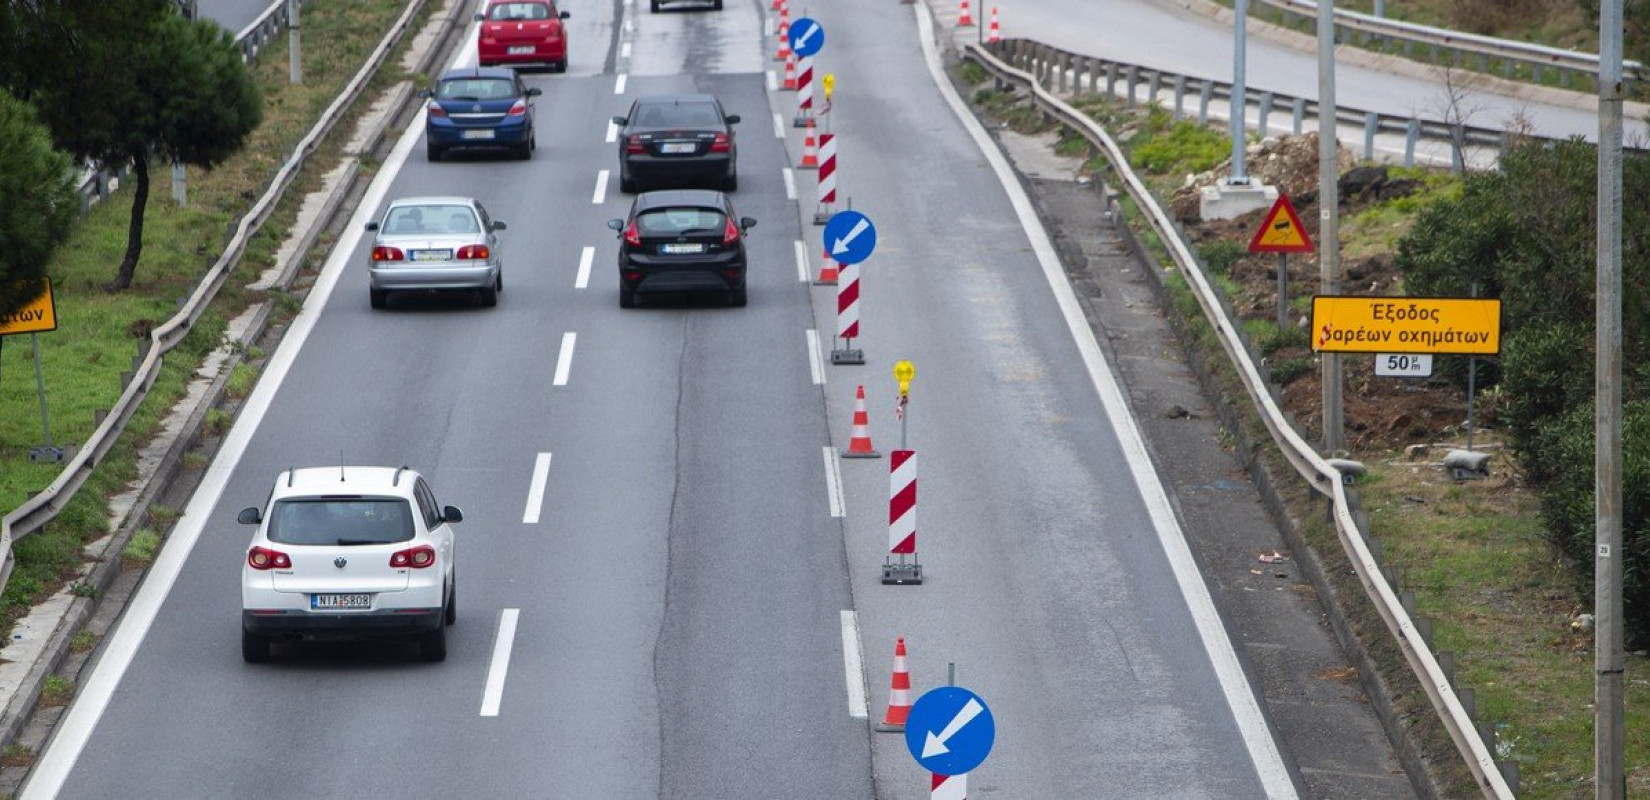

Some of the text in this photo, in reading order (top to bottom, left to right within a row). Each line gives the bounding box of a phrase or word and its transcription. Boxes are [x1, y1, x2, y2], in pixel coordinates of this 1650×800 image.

[1370, 303, 1439, 322] Έξοδος
[1399, 327, 1490, 346] οχημάτων
[1387, 355, 1409, 370] 50
